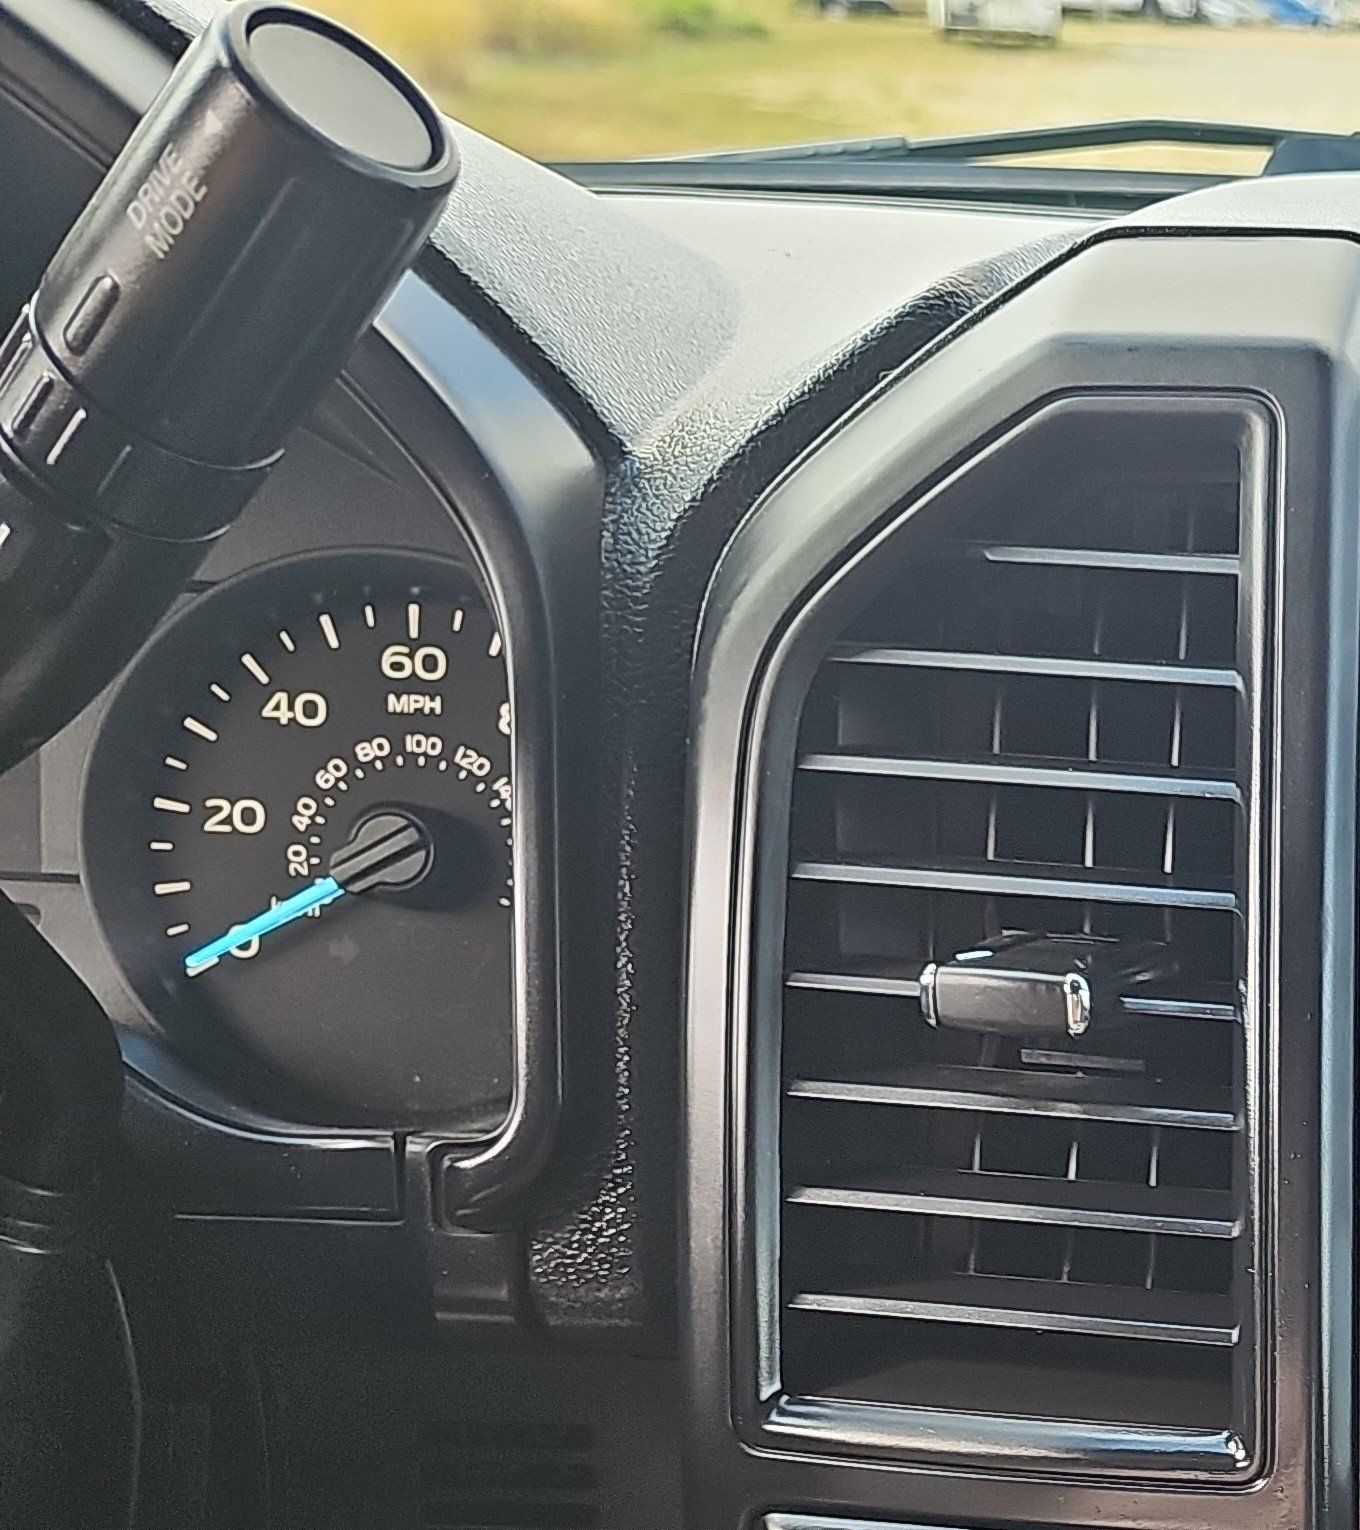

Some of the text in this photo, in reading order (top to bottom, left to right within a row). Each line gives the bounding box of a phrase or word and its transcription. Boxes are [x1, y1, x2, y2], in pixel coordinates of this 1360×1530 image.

[126, 142, 181, 230] DRIVE
[144, 169, 208, 259] MODE
[380, 645, 448, 682] 60
[261, 691, 328, 727] 40
[388, 693, 442, 716] MPH
[354, 736, 391, 764] 80
[405, 733, 443, 757] 100
[454, 745, 491, 777] 120
[315, 757, 349, 790] 60
[203, 797, 266, 834] 20
[291, 796, 319, 832] 40
[286, 844, 309, 877] 20
